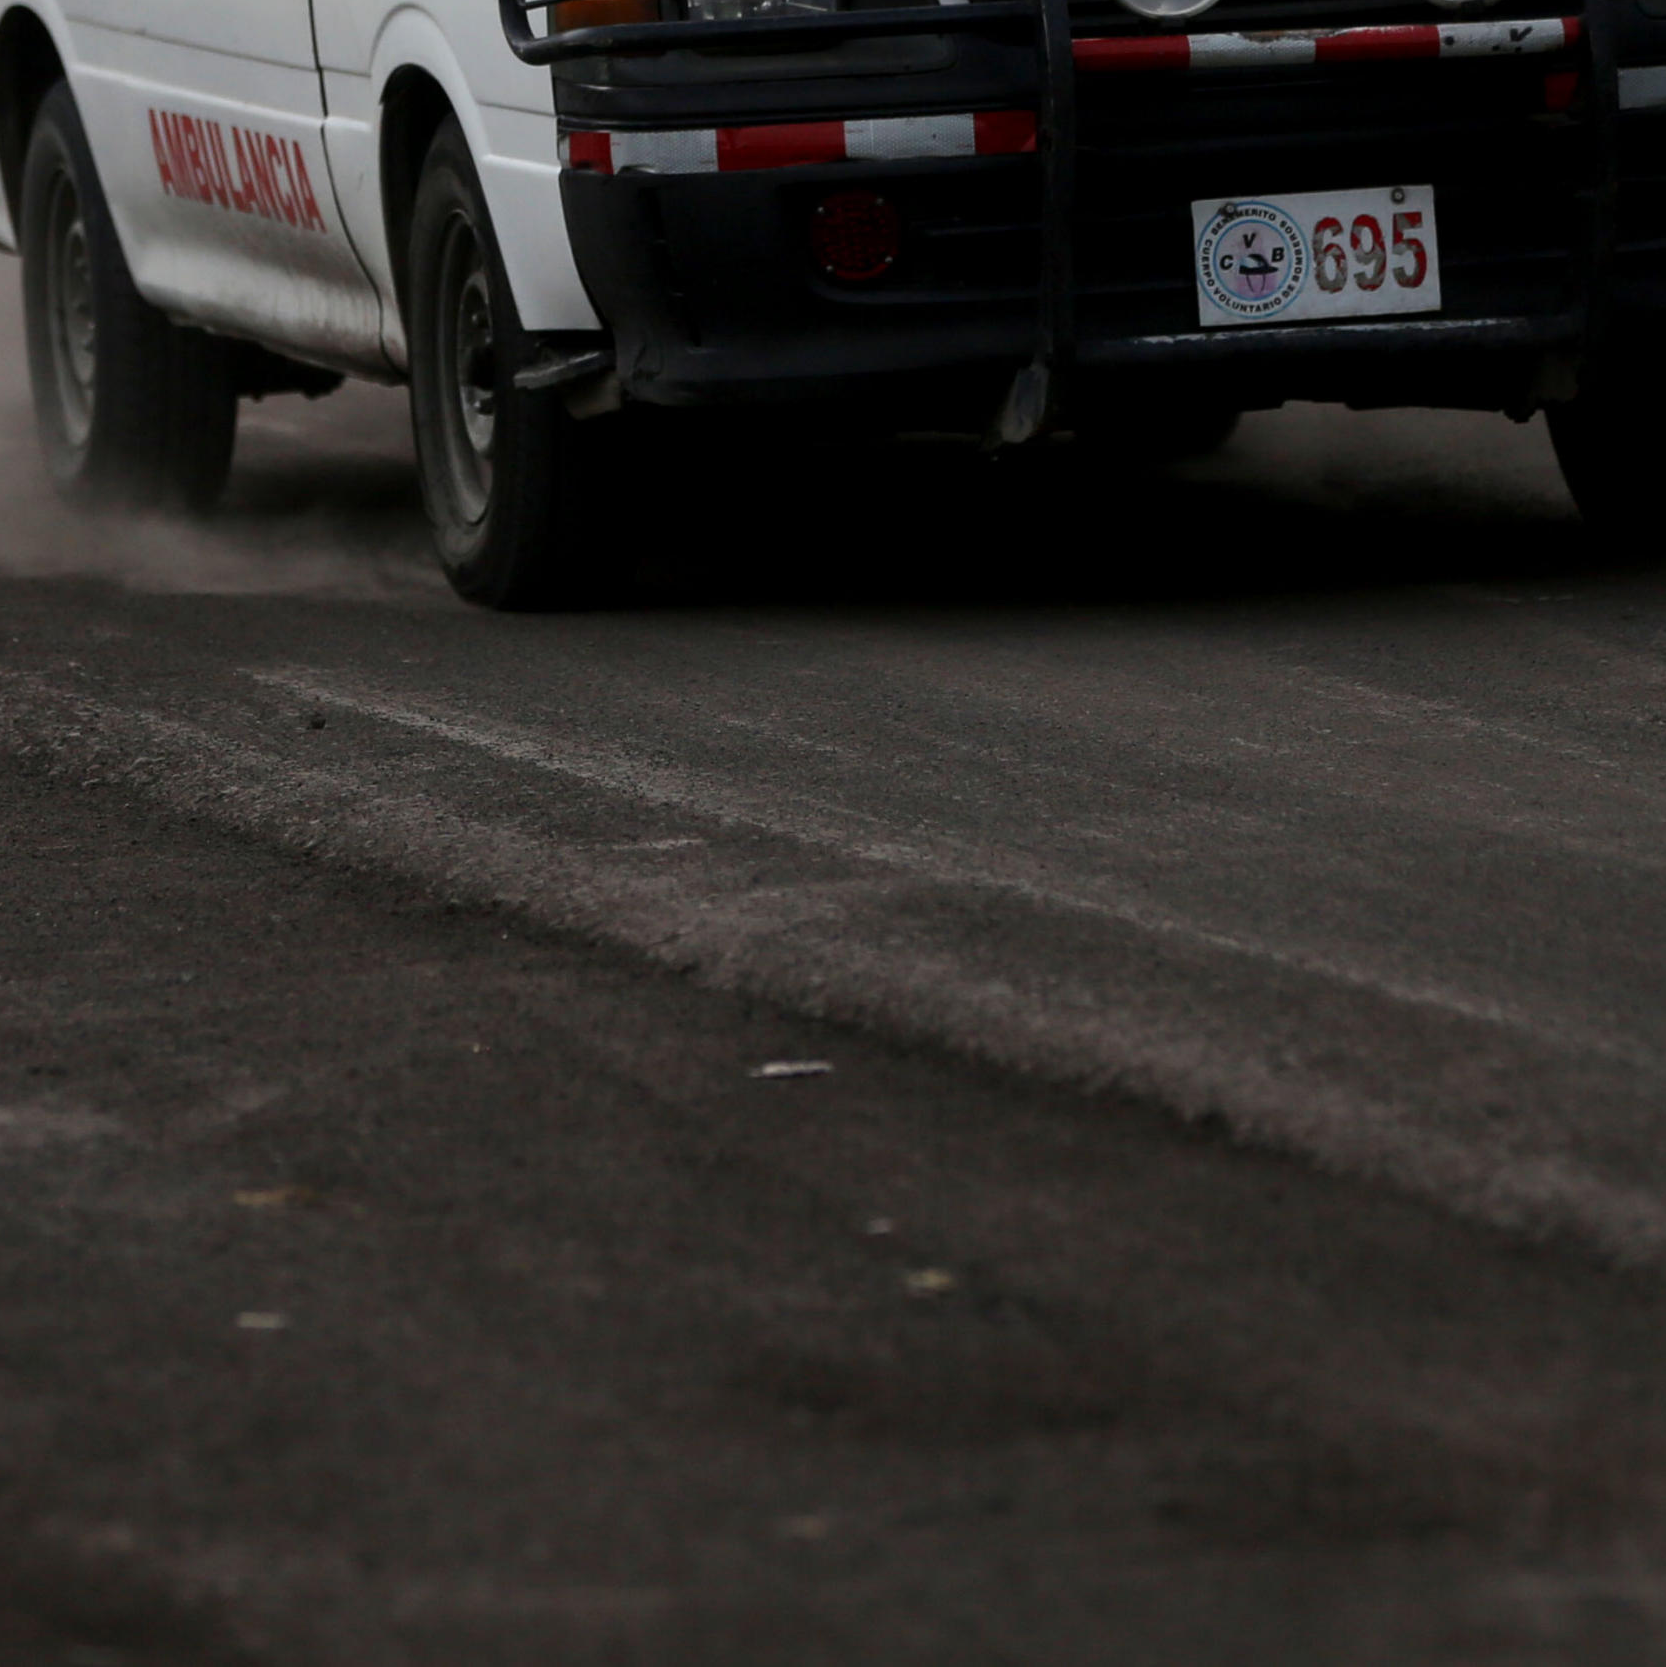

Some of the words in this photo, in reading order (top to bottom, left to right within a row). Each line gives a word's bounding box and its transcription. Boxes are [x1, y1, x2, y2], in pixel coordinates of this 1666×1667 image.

[149, 109, 327, 234] AMBULANCIA
[1199, 238, 1216, 288] CUERPO
[1213, 289, 1282, 314] VOLUNTARIO
[1279, 220, 1305, 282] BOMBEROS
[1312, 211, 1427, 293] 695
